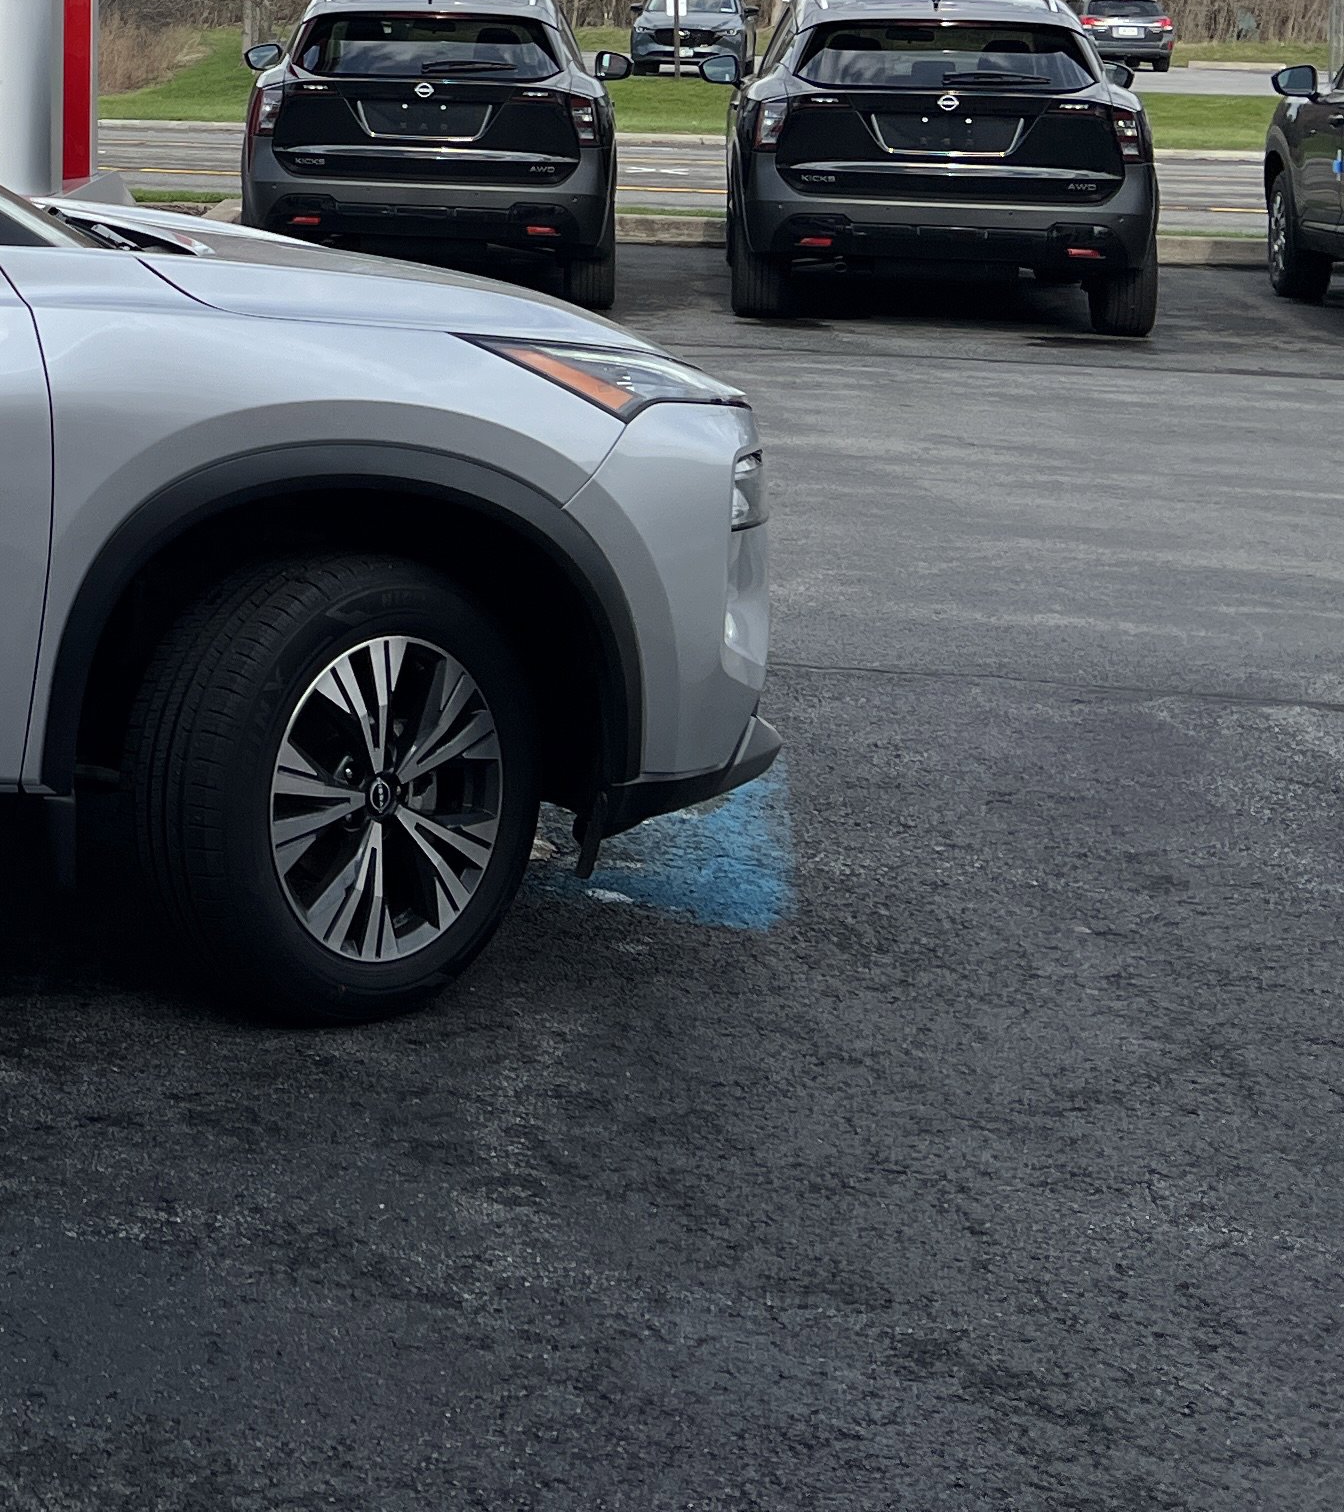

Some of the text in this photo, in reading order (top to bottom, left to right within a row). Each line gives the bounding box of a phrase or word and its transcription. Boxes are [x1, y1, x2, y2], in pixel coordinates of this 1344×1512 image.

[295, 157, 325, 165] KICKS
[801, 174, 836, 182] KICKS
[1067, 183, 1097, 191] AWD
